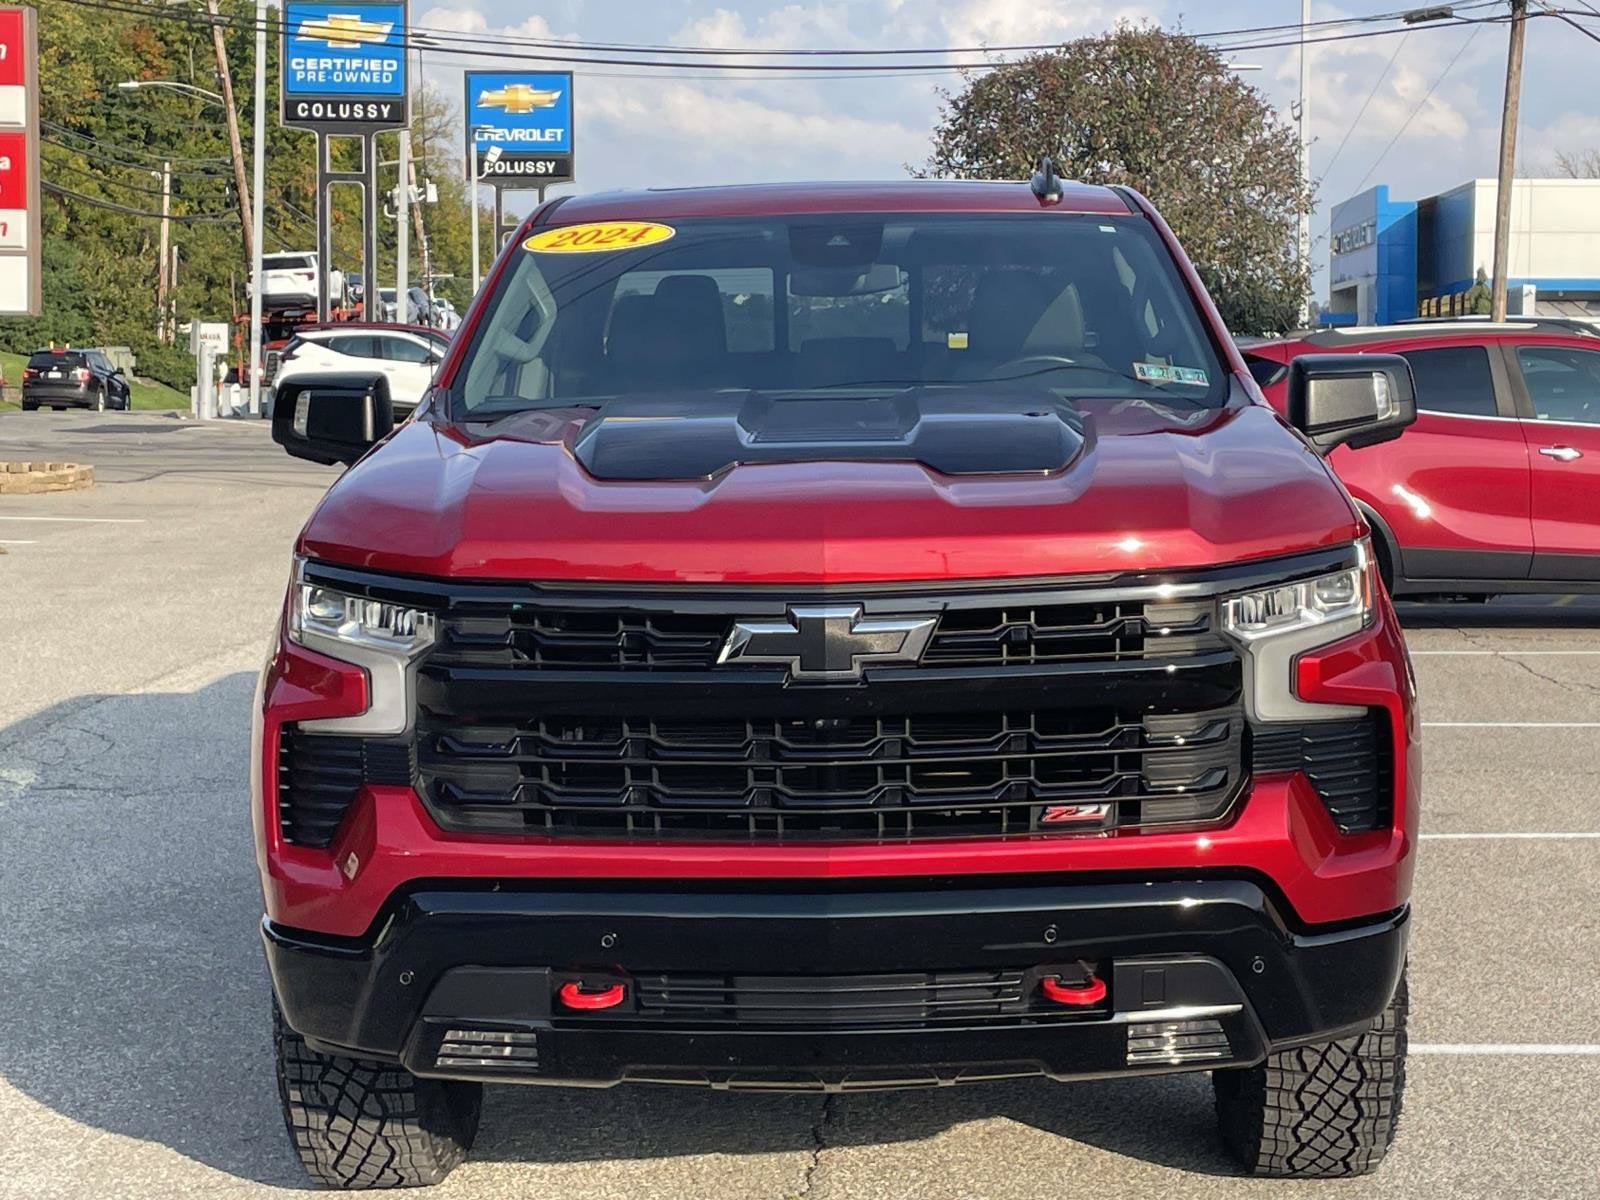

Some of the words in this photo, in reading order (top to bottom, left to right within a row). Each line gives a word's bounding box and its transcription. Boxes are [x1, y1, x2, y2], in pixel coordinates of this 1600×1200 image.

[291, 58, 398, 71] CERTIFIED
[296, 71, 393, 83] PRE-OWNED
[297, 102, 391, 118] COLUSSY
[545, 226, 654, 248] 2024
[1041, 803, 1112, 822] Z71
